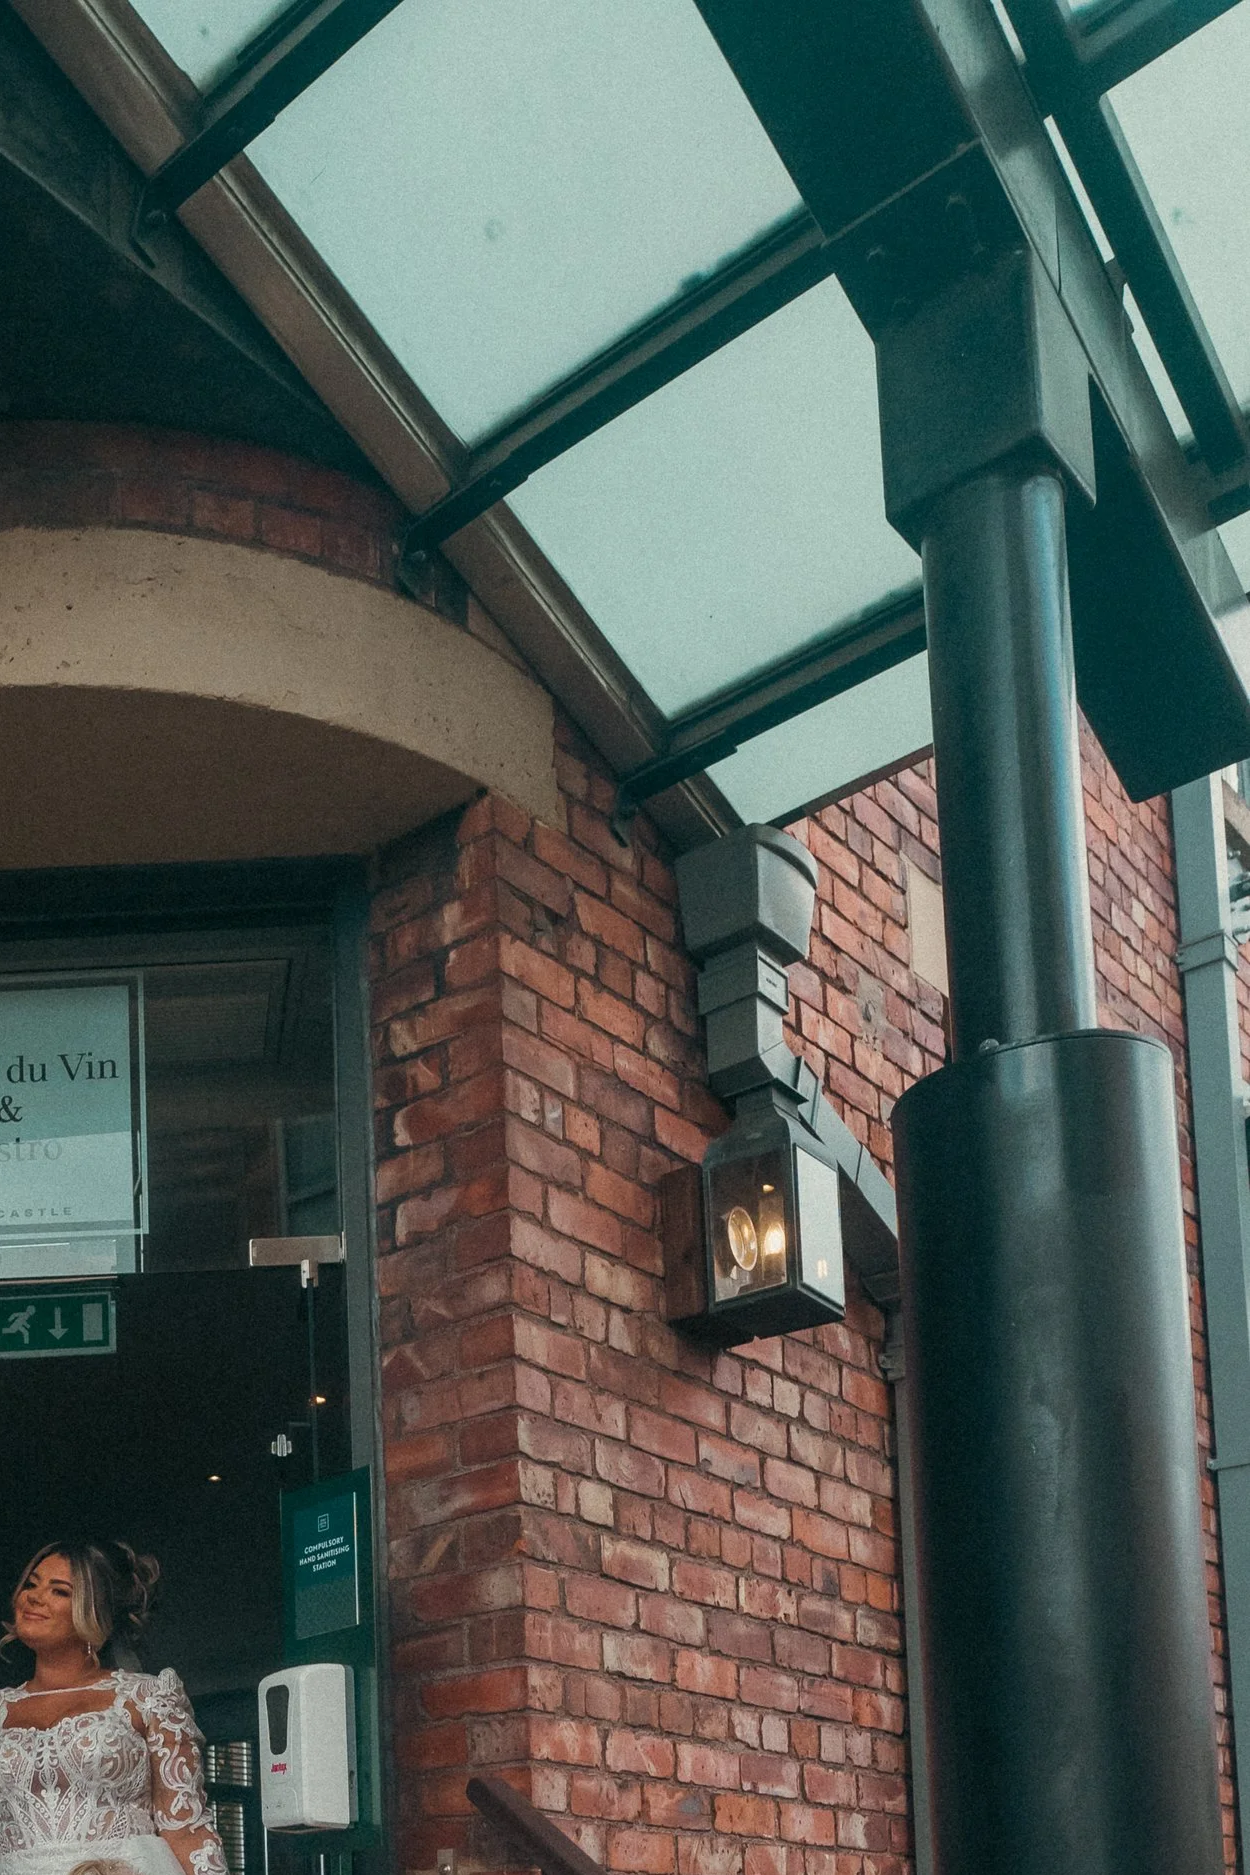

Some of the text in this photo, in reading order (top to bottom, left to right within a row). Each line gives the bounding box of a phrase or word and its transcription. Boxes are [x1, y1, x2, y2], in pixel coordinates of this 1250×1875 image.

[6, 1055, 48, 1084] du
[57, 1052, 119, 1081] Vin
[304, 1536, 345, 1555] COMPULSORY
[299, 1545, 351, 1567] HAND SANITISING
[312, 1558, 337, 1573] STATION
